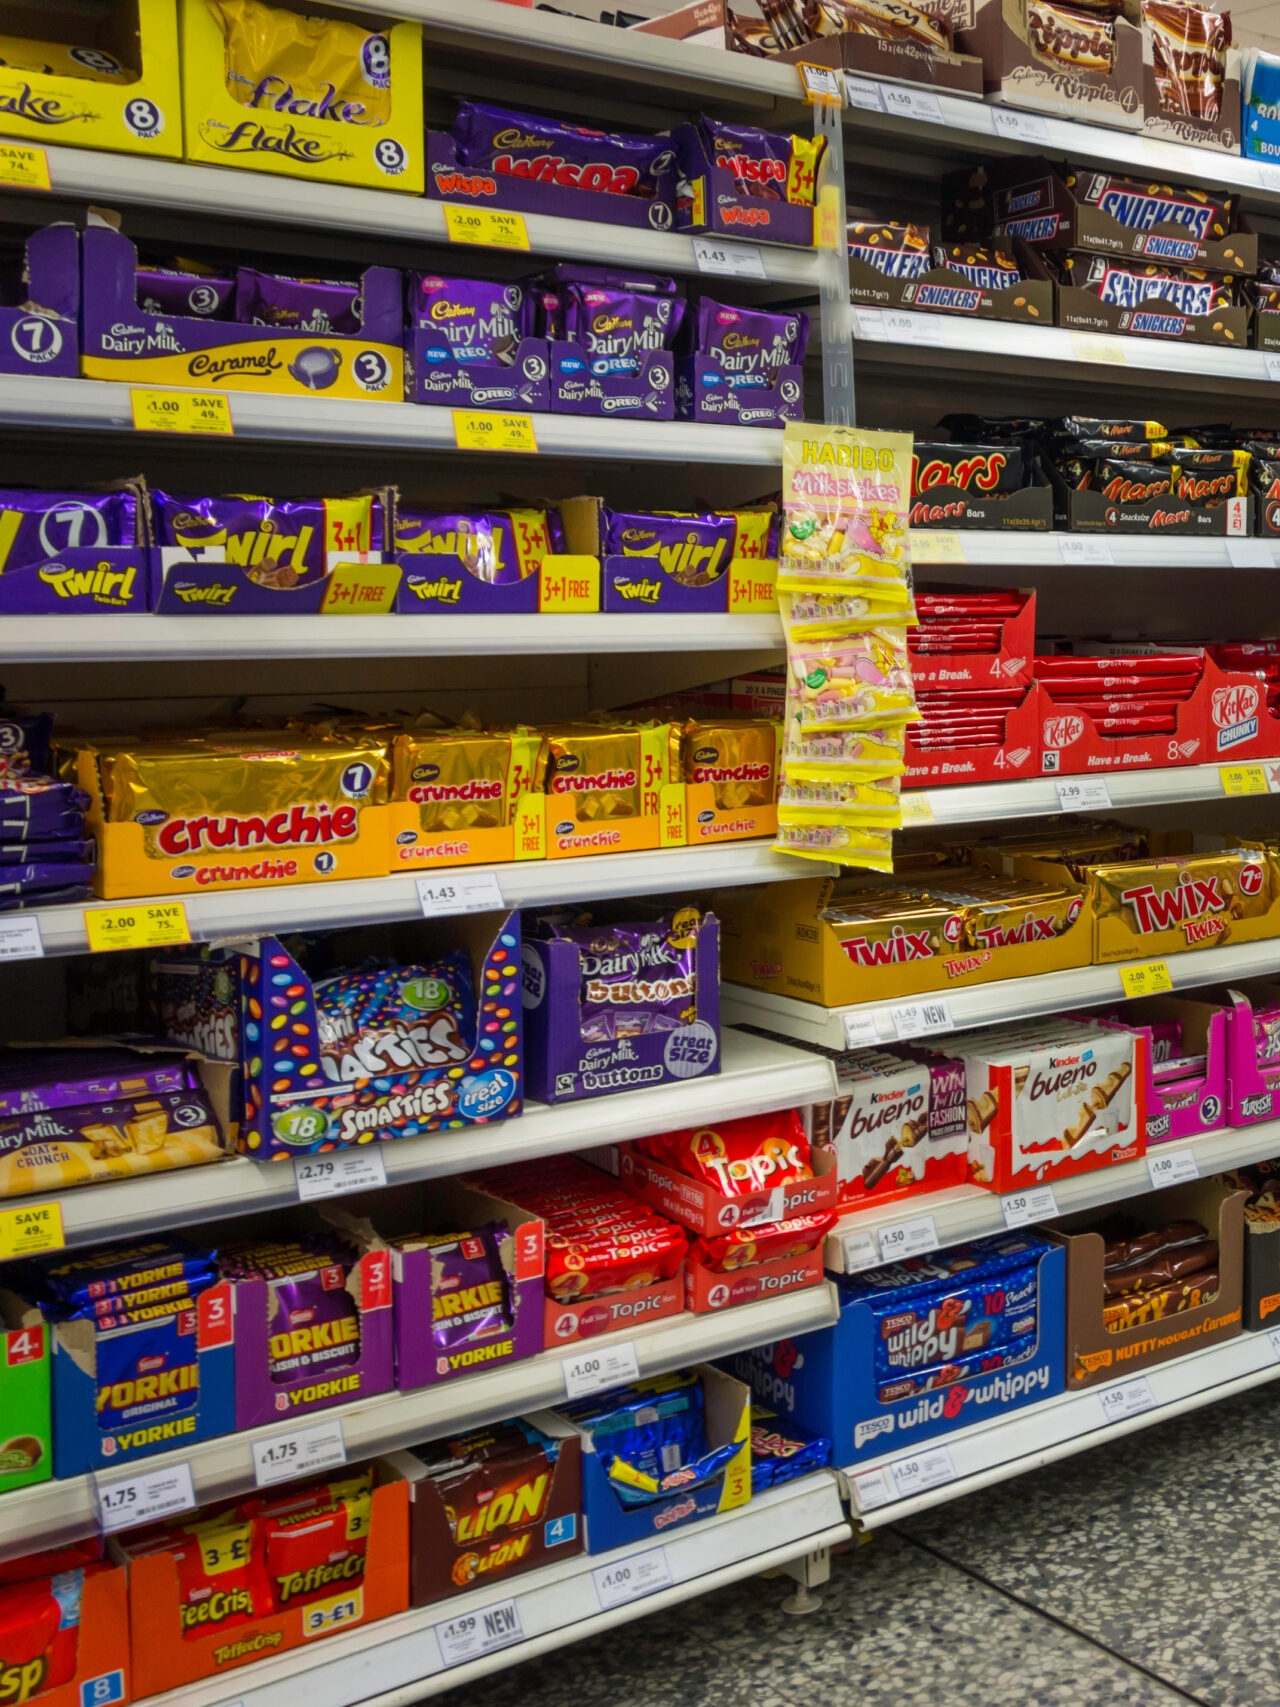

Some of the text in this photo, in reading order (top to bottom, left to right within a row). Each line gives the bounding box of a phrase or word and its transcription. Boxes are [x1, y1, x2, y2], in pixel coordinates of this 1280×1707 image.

[1011, 67, 1047, 85] Galaxy
[1050, 73, 1138, 110] Ripple 4
[493, 129, 555, 150] Cadbury
[716, 155, 787, 183] Wispa
[435, 174, 497, 197] Wispa
[490, 215, 517, 226] SAVE
[719, 206, 771, 226] Wispa
[1005, 215, 1061, 242] SNICKERS
[1145, 236, 1199, 261] SNICKERS
[915, 285, 983, 309] SNICKERS
[431, 300, 475, 321] Cadbury
[593, 316, 633, 333] Cadbury
[101, 334, 181, 354] Dairy Milk
[188, 348, 283, 381] Caramel
[593, 357, 637, 375] OREO
[192, 398, 224, 408] SAVE
[503, 418, 528, 429] SAVE
[802, 440, 895, 473] HARIBO
[792, 470, 899, 502] Milkshakes
[1178, 474, 1235, 501] Mars
[909, 501, 985, 524] Mars Bars
[1109, 509, 1190, 528] 4 Snacksize Mars
[39, 563, 137, 599] Twirl
[407, 579, 462, 602] Twirl
[544, 578, 590, 601] 3+1 FREE
[732, 580, 774, 602] 3+1 FREE
[329, 582, 385, 604] 3+1 FREE
[1213, 688, 1259, 724] KitKat
[1046, 717, 1082, 746] KitKat
[1218, 718, 1258, 750] CHUNKY
[667, 803, 682, 821] 3+1
[522, 819, 540, 835] 3+1
[667, 824, 682, 839] FREE
[522, 837, 540, 851] FREE
[147, 907, 179, 920] SAVE
[1149, 964, 1165, 973] SAVE
[673, 1035, 713, 1049] treat
[668, 1046, 709, 1064] size
[1049, 1054, 1081, 1069] kinder
[583, 1064, 663, 1090] buttons
[932, 1071, 965, 1094] WIN
[1030, 1061, 1098, 1101] bueno
[464, 1075, 508, 1107] treat
[870, 1089, 906, 1104] kinder
[477, 1095, 504, 1115] size
[288, 1115, 318, 1138] 18
[851, 1094, 924, 1139] bueno
[930, 1109, 965, 1127] FASHION
[16, 1151, 71, 1169] CRUNCH
[706, 1144, 805, 1182] Topic
[1005, 1198, 1027, 1212] £1.50
[15, 1209, 50, 1224] SAVE
[525, 1235, 537, 1253] 3
[881, 1230, 904, 1245] £1.50
[607, 1241, 660, 1261] Topic
[119, 1262, 184, 1290] YORKIE
[369, 1262, 384, 1284] 3
[713, 1269, 805, 1305] 4 Topic
[208, 1298, 224, 1320] 3
[561, 1295, 662, 1333] 4 Full Size Topic
[984, 1292, 1004, 1316] 10
[885, 1314, 912, 1328] TESCO
[888, 1307, 936, 1354] wild
[1203, 1308, 1241, 1333] Caramel
[311, 1343, 355, 1365] BISCUIT
[448, 1341, 513, 1369] YORKIE
[888, 1327, 958, 1367] whippy
[1082, 1326, 1202, 1365] TESCO NUTTY NOUGAT
[290, 1374, 361, 1405] YORKIE
[859, 1365, 1050, 1434] TESCO wild & whippy
[121, 1397, 178, 1419] ORIGINAL
[117, 1416, 196, 1449] YORKIE
[262, 1443, 297, 1464] £1.75
[731, 1478, 743, 1497] 3
[550, 1521, 564, 1537] 4
[602, 1569, 631, 1588] £1.00
[309, 1602, 356, 1629] 3 £1
[443, 1606, 516, 1638] £1.99 NEW
[94, 1677, 110, 1699] 8
